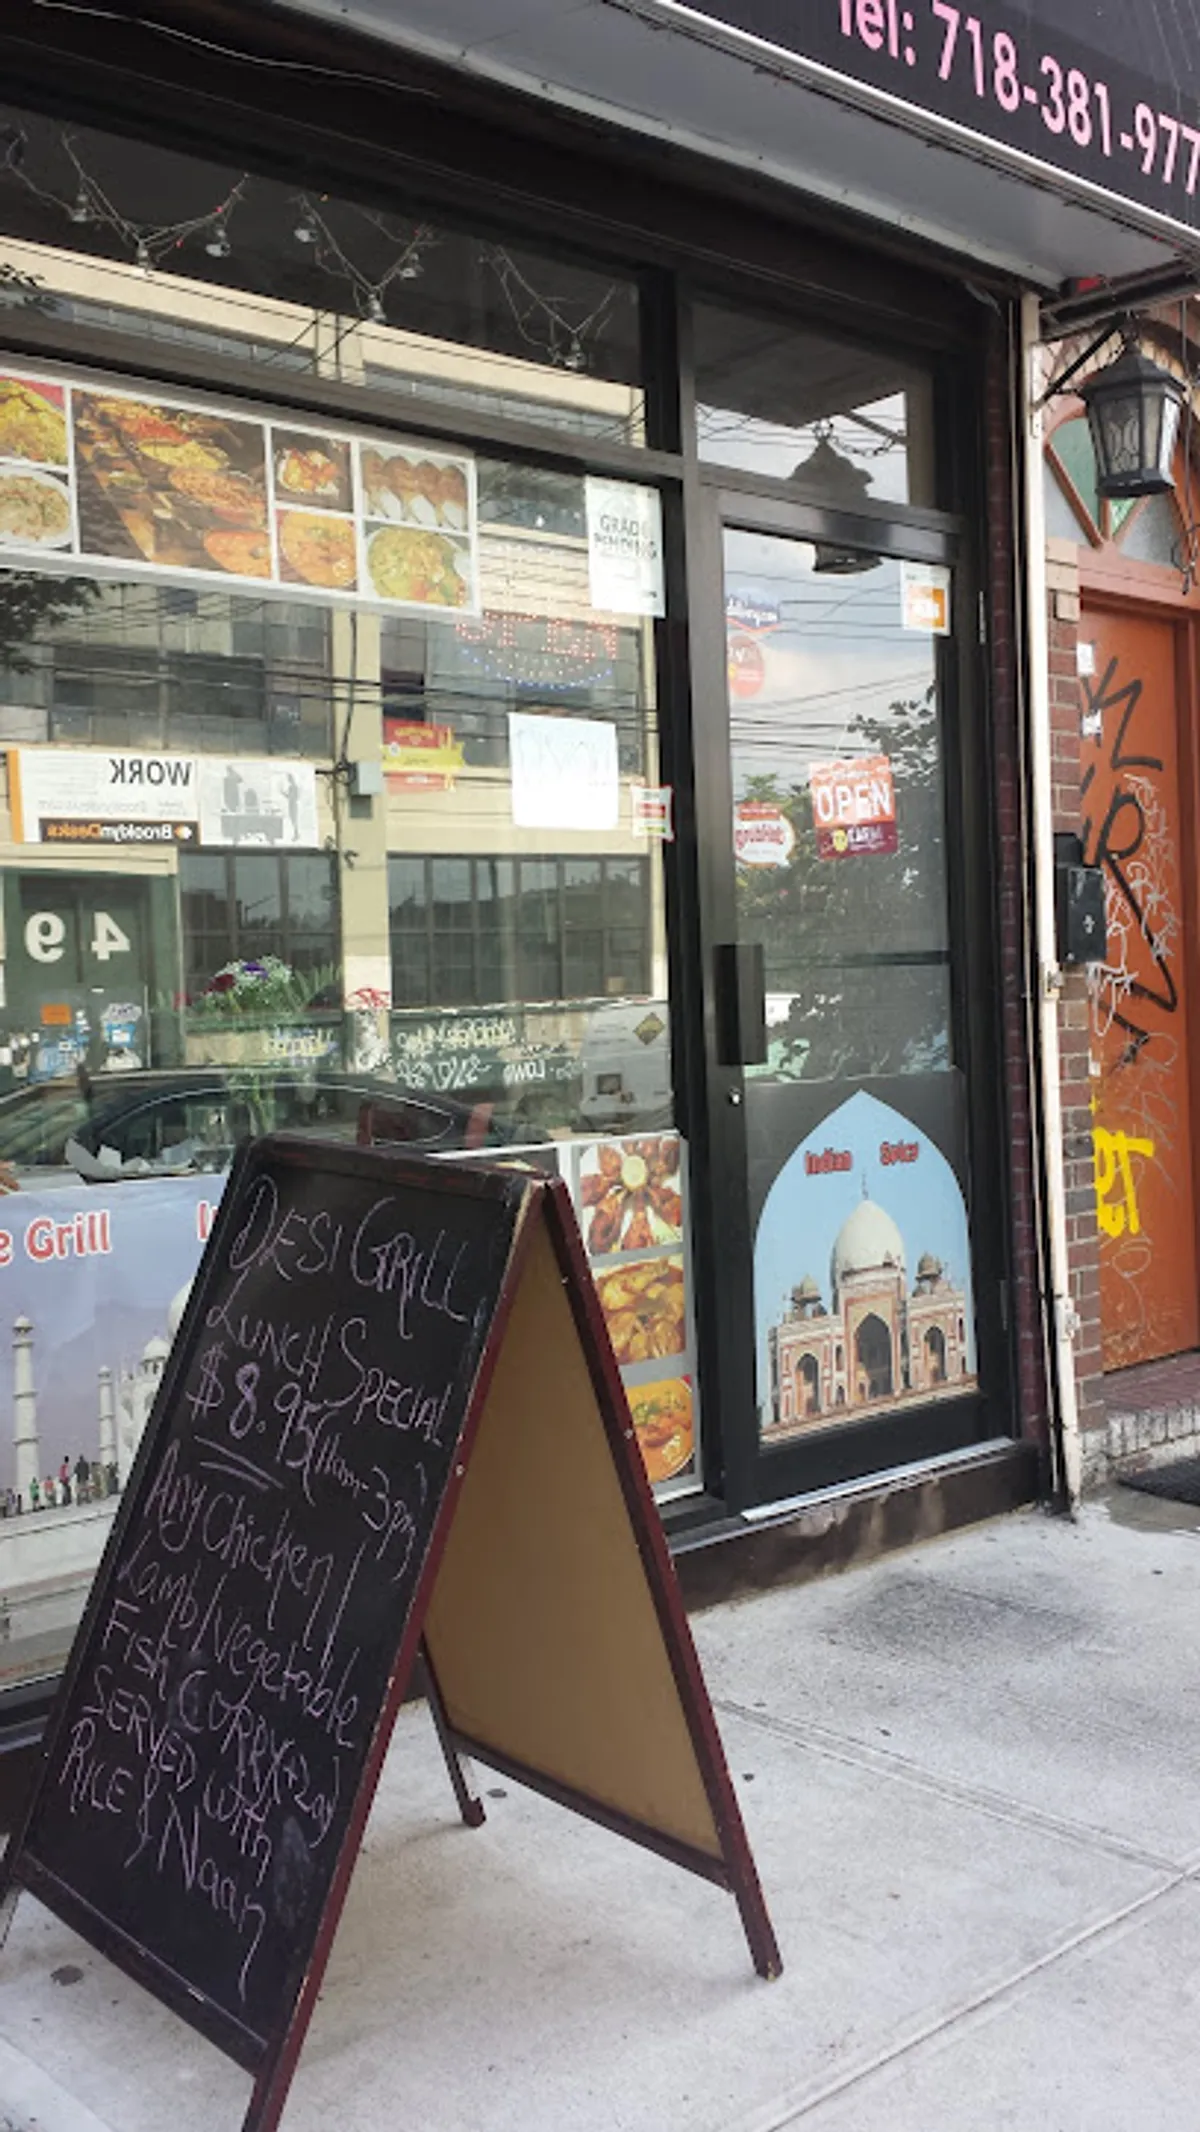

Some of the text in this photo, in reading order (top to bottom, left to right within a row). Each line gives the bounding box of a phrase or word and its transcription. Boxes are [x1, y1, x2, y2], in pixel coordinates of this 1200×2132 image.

[817, 779, 892, 822] OPEN
[805, 1149, 851, 1173] Indian
[27, 1212, 110, 1259] Grill
